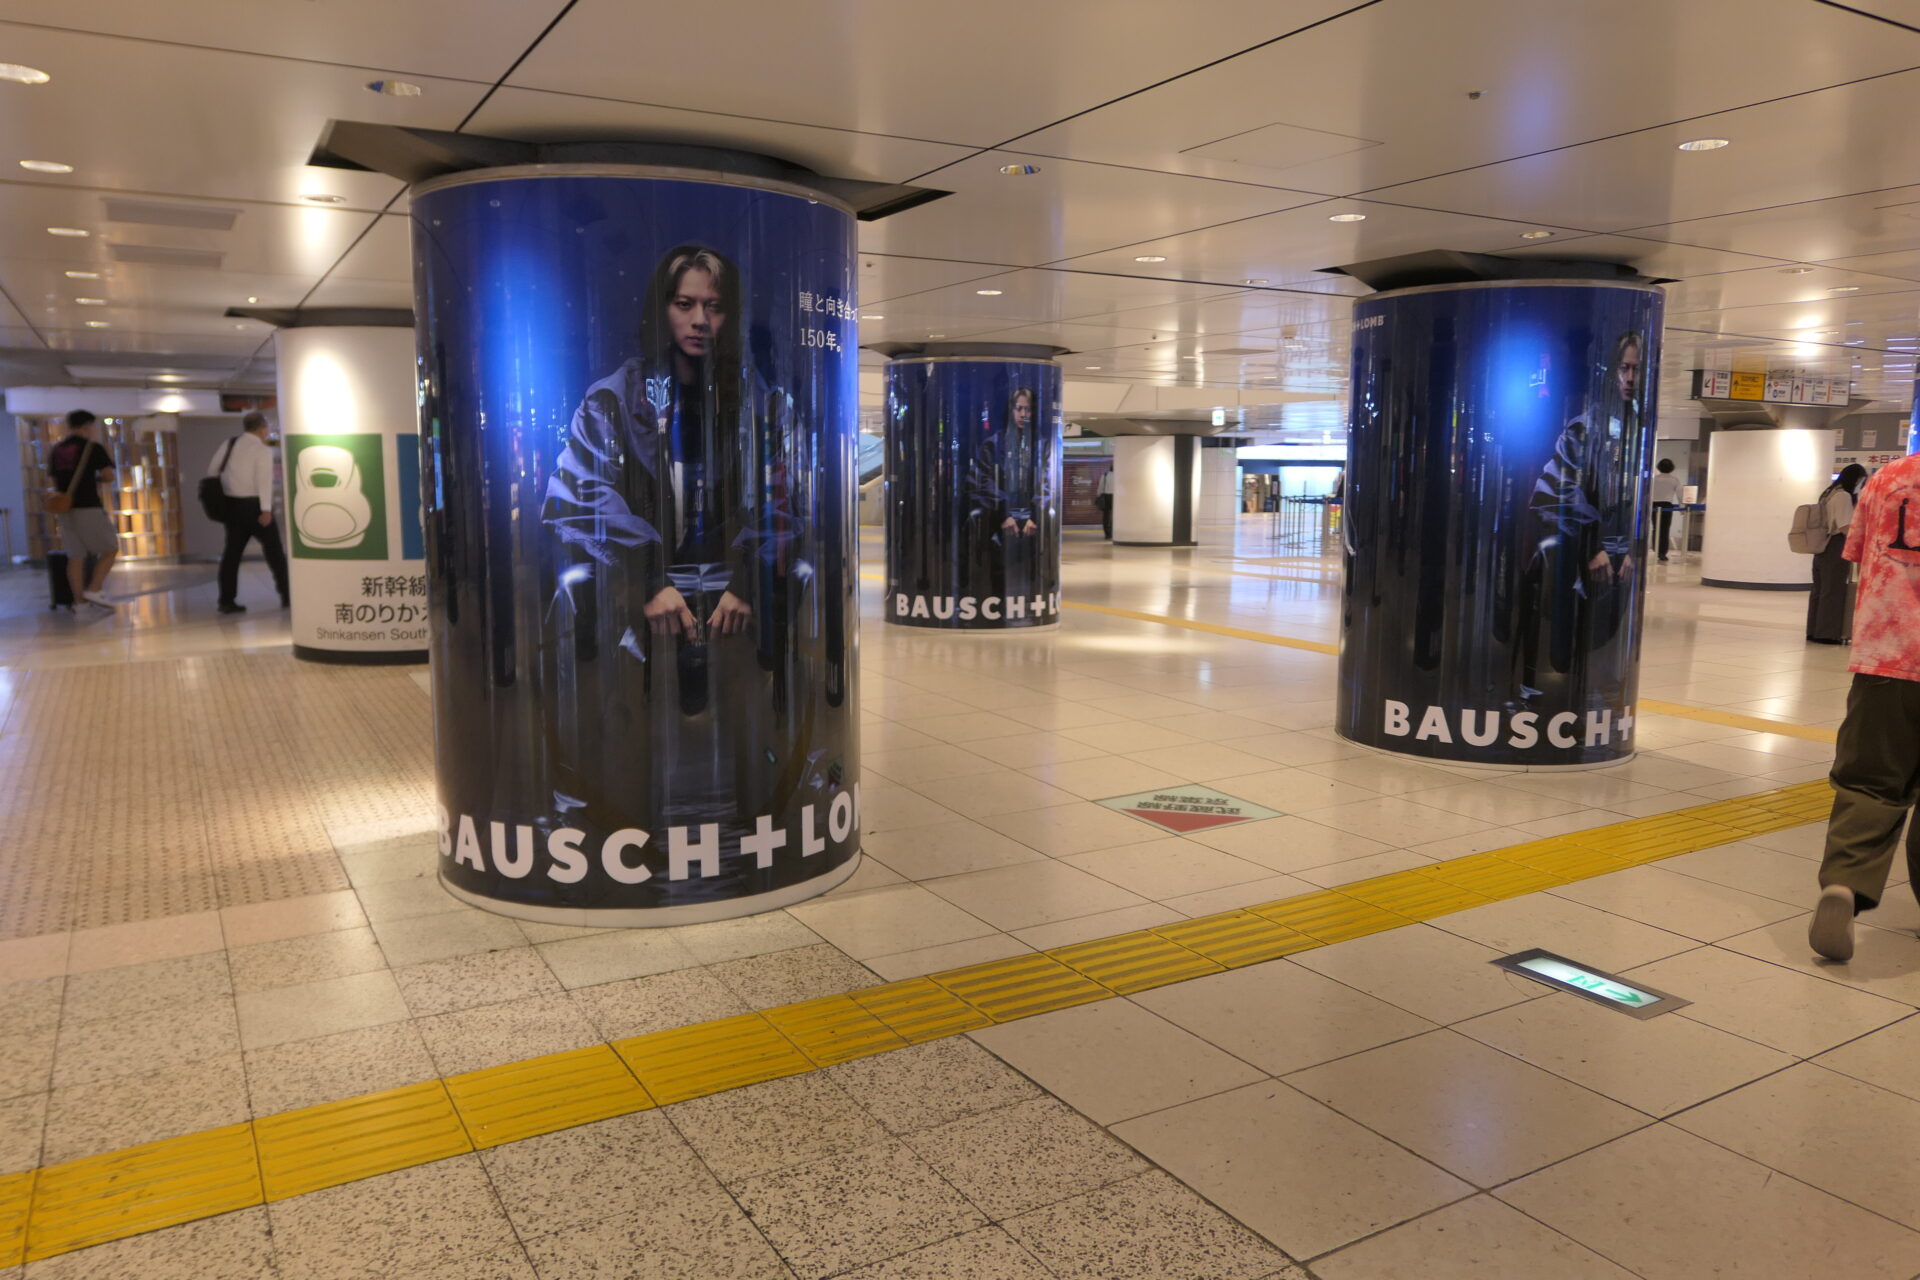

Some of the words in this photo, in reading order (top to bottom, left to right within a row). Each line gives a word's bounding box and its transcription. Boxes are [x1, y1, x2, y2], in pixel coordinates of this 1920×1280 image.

[800, 328, 841, 353] 150年。
[896, 592, 1060, 621] BAUSCH+L
[316, 627, 386, 641] Shinkansen
[438, 782, 859, 884] BAUSCH+LO
